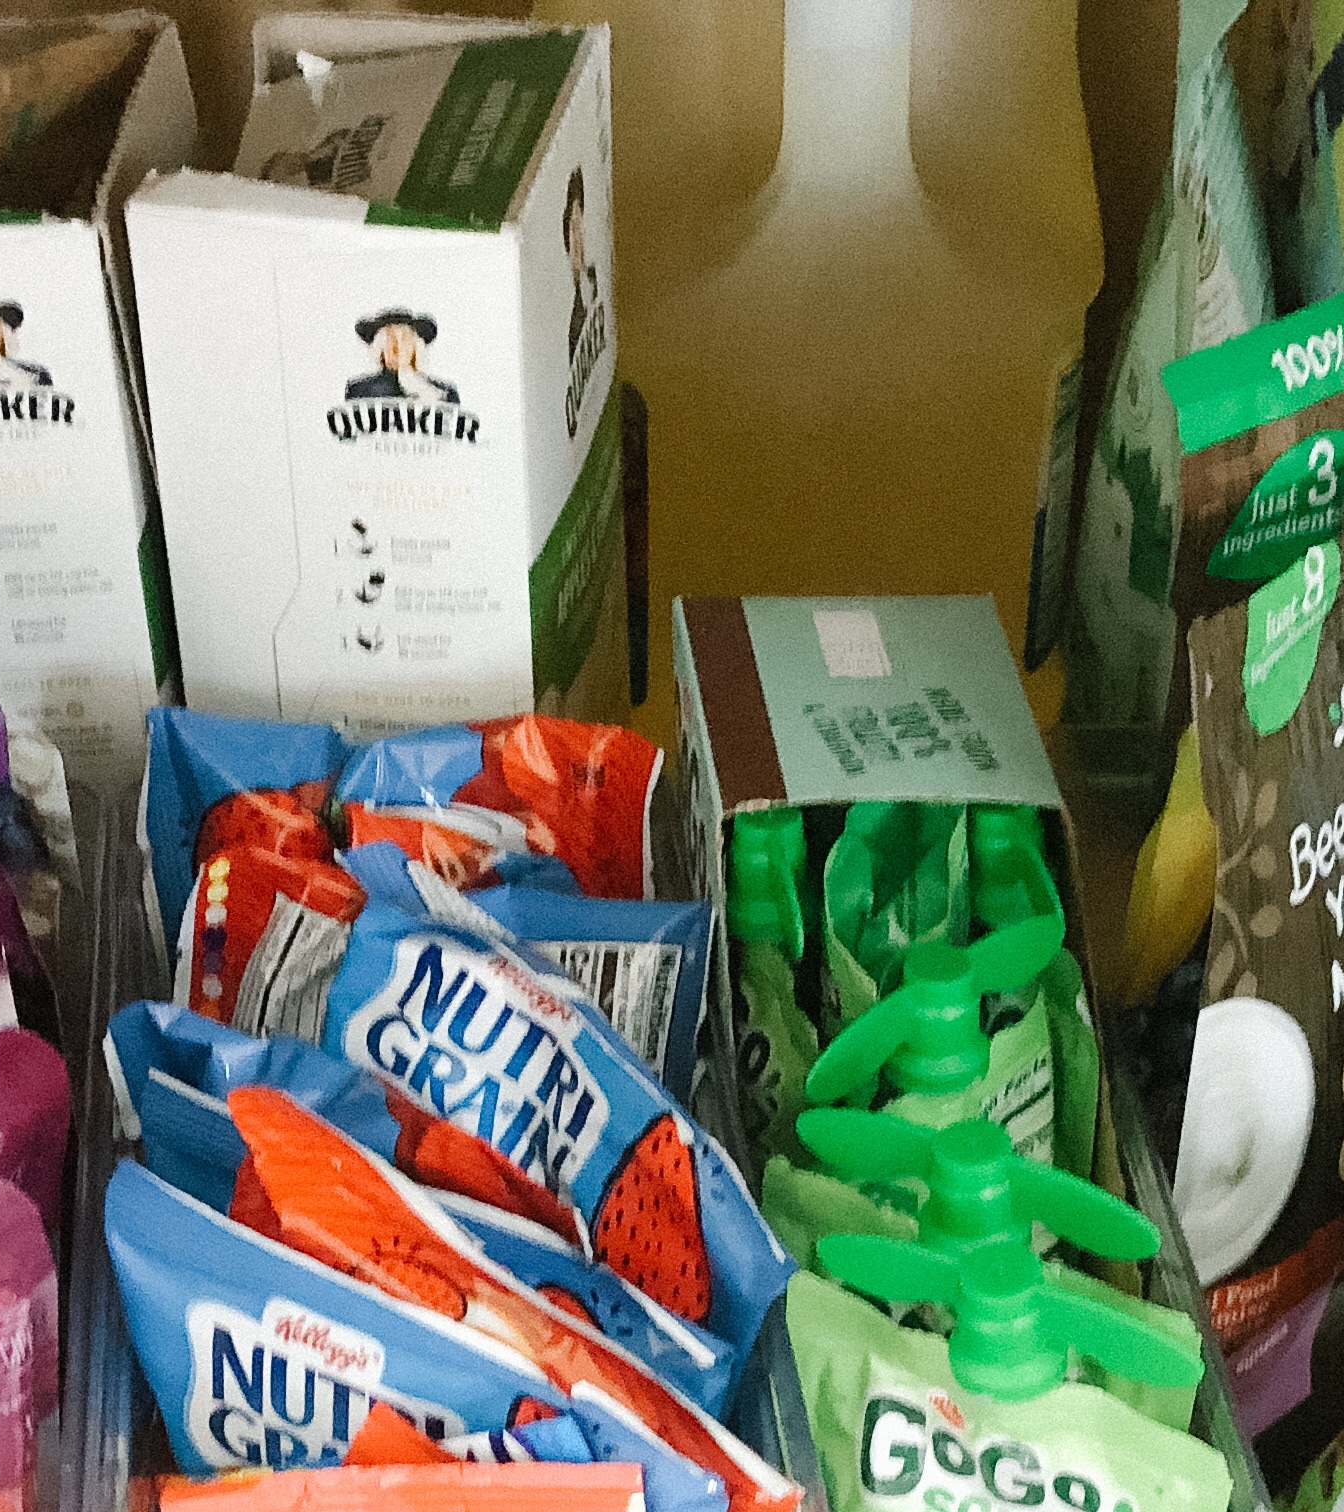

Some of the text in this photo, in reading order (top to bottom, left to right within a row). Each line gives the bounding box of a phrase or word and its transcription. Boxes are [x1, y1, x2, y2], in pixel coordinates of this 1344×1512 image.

[326, 402, 481, 442] QUAKER
[1307, 437, 1338, 507] 3
[397, 942, 596, 1144] NUTRI
